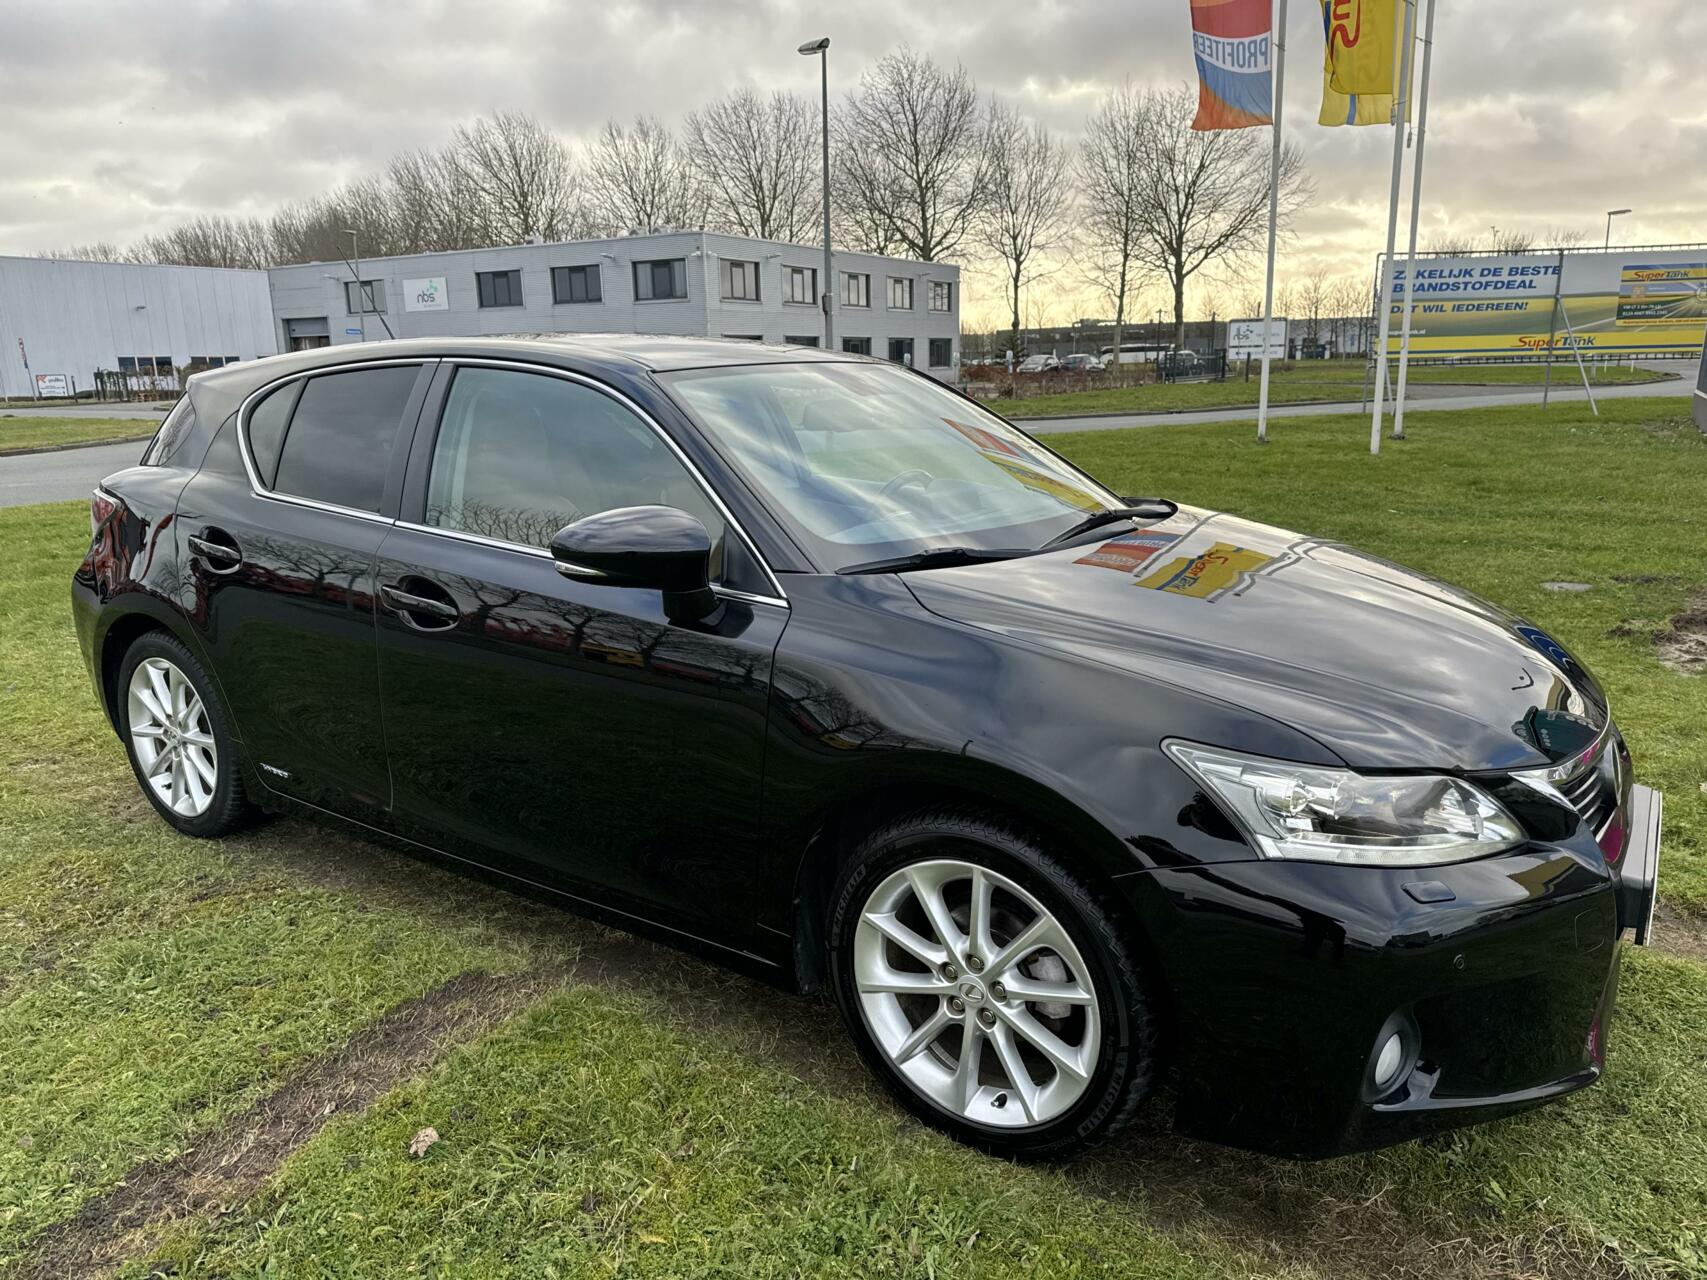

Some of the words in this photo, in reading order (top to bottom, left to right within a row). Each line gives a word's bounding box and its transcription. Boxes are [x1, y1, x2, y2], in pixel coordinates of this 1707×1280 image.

[1393, 268, 1475, 280] ZKELIJK
[1479, 267, 1501, 277] DE
[1632, 271, 1690, 282] SuperTank
[416, 290, 436, 303] nbs
[1391, 305, 1418, 314] DT
[1422, 304, 1447, 312] WIL
[1451, 302, 1529, 312] IEDEREEN!
